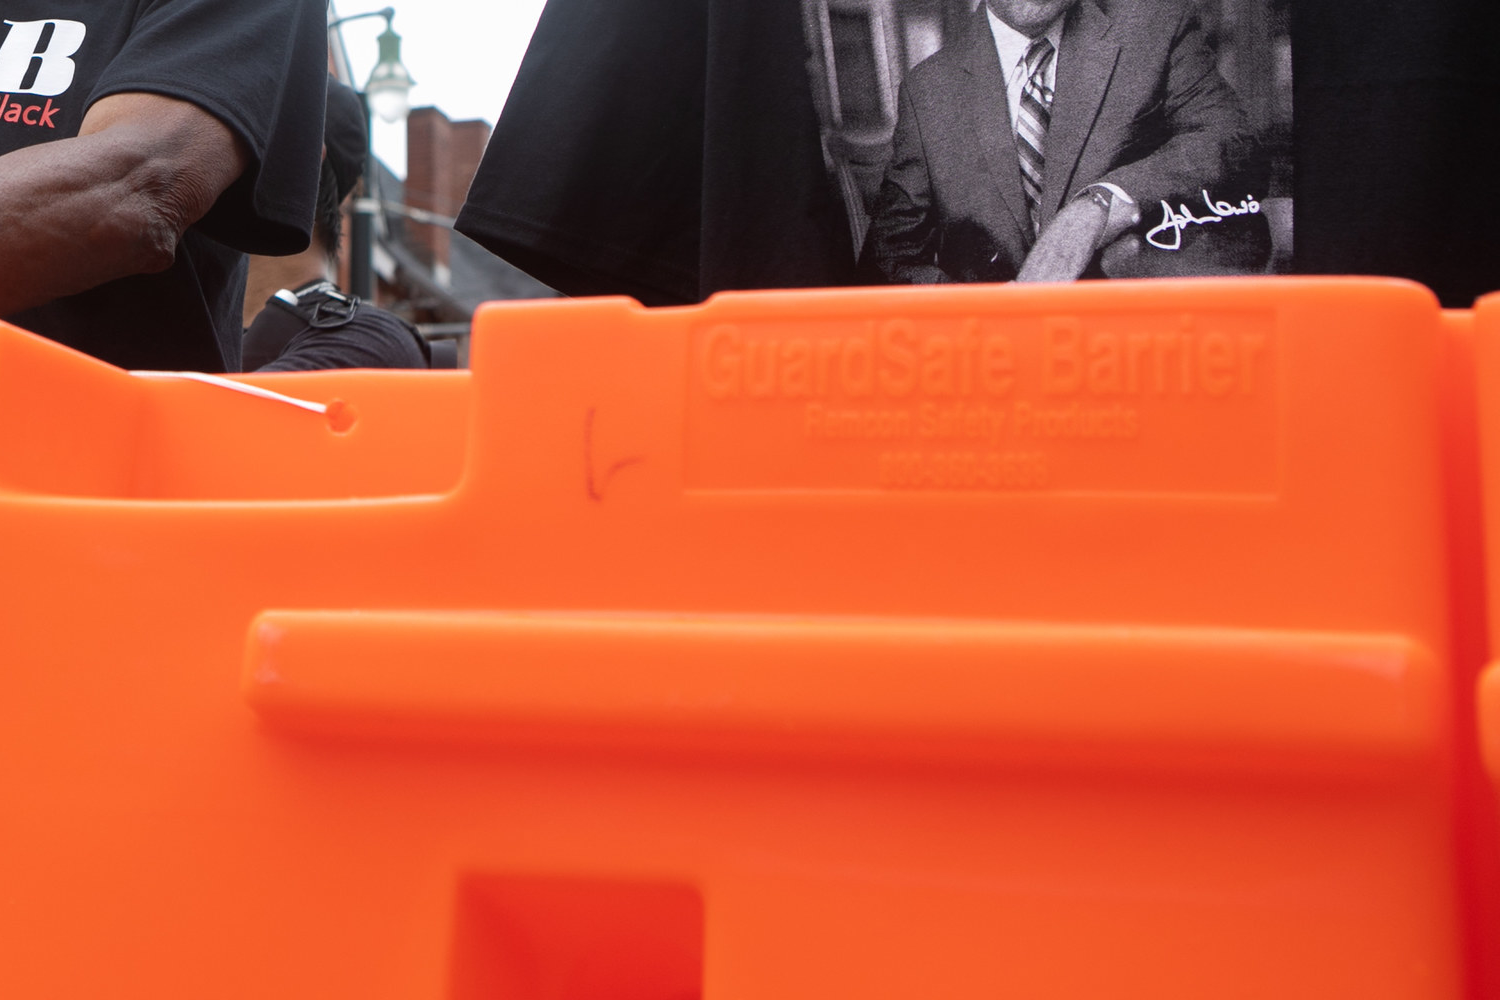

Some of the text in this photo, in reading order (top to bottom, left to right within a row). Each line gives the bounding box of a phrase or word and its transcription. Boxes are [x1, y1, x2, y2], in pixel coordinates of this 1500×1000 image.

[698, 314, 1266, 400] GuardSafe Barrier
[918, 401, 1004, 446] Safety
[1013, 400, 1139, 439] Products
